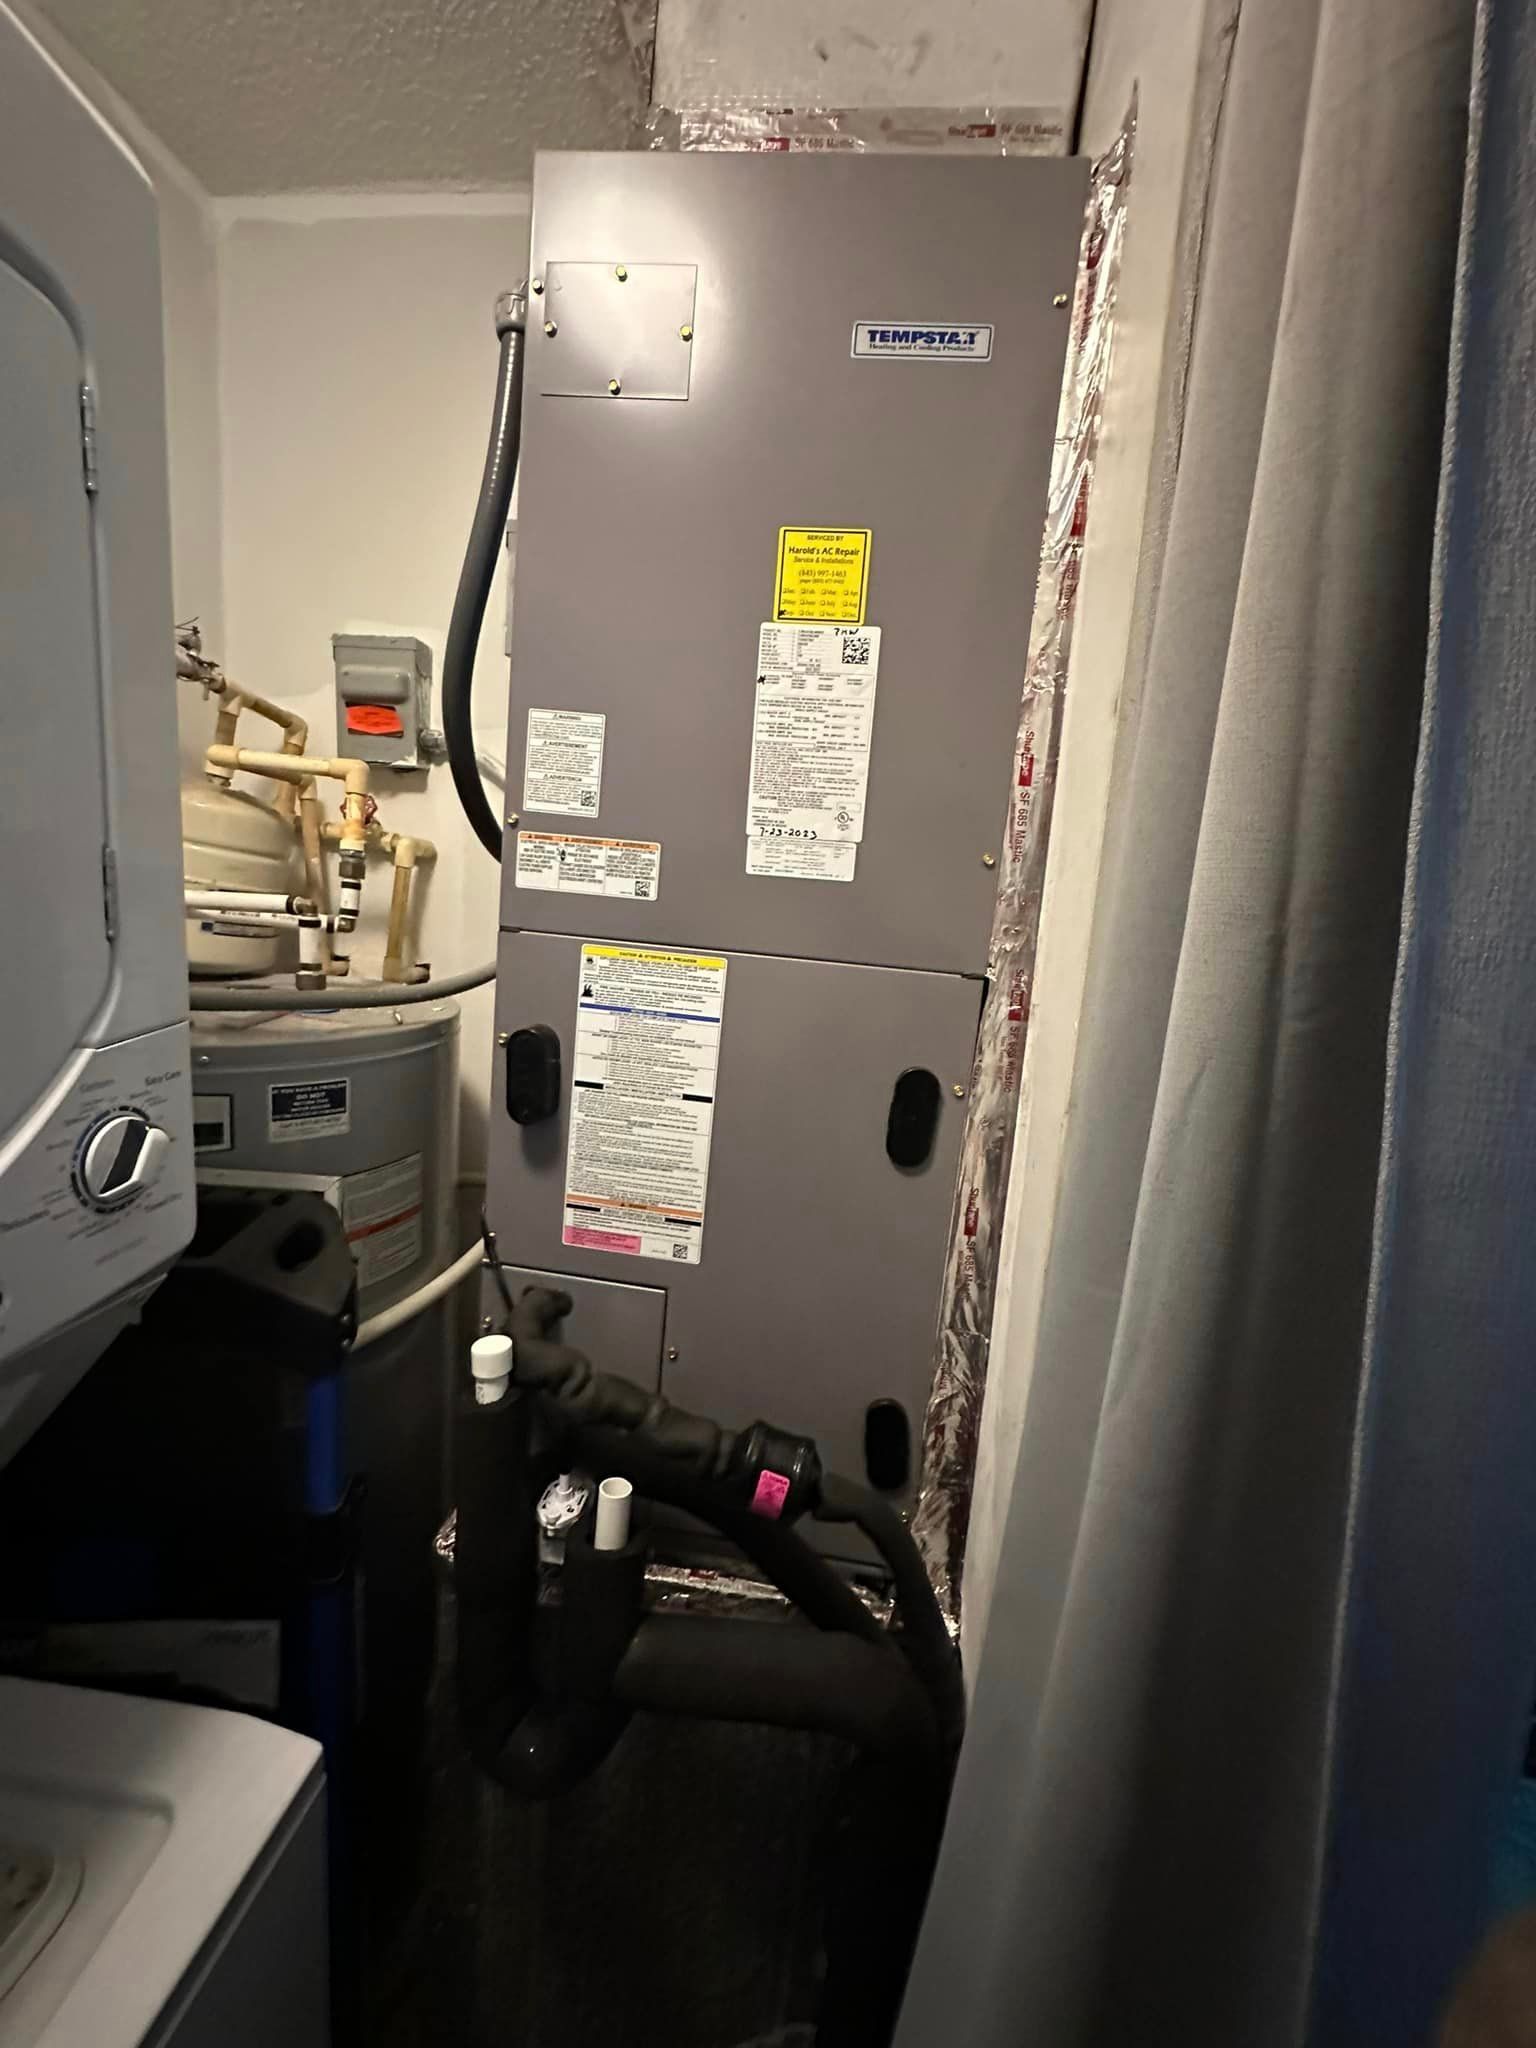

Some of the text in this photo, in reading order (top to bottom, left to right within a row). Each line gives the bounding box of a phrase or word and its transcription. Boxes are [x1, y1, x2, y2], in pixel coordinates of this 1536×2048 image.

[869, 343, 897, 351] Heating
[913, 344, 941, 352] Cooling
[788, 546, 860, 557] Harold's AC Repair
[1019, 791, 1031, 806] SF
[1017, 808, 1030, 827] 685
[1012, 829, 1027, 864] Mastic
